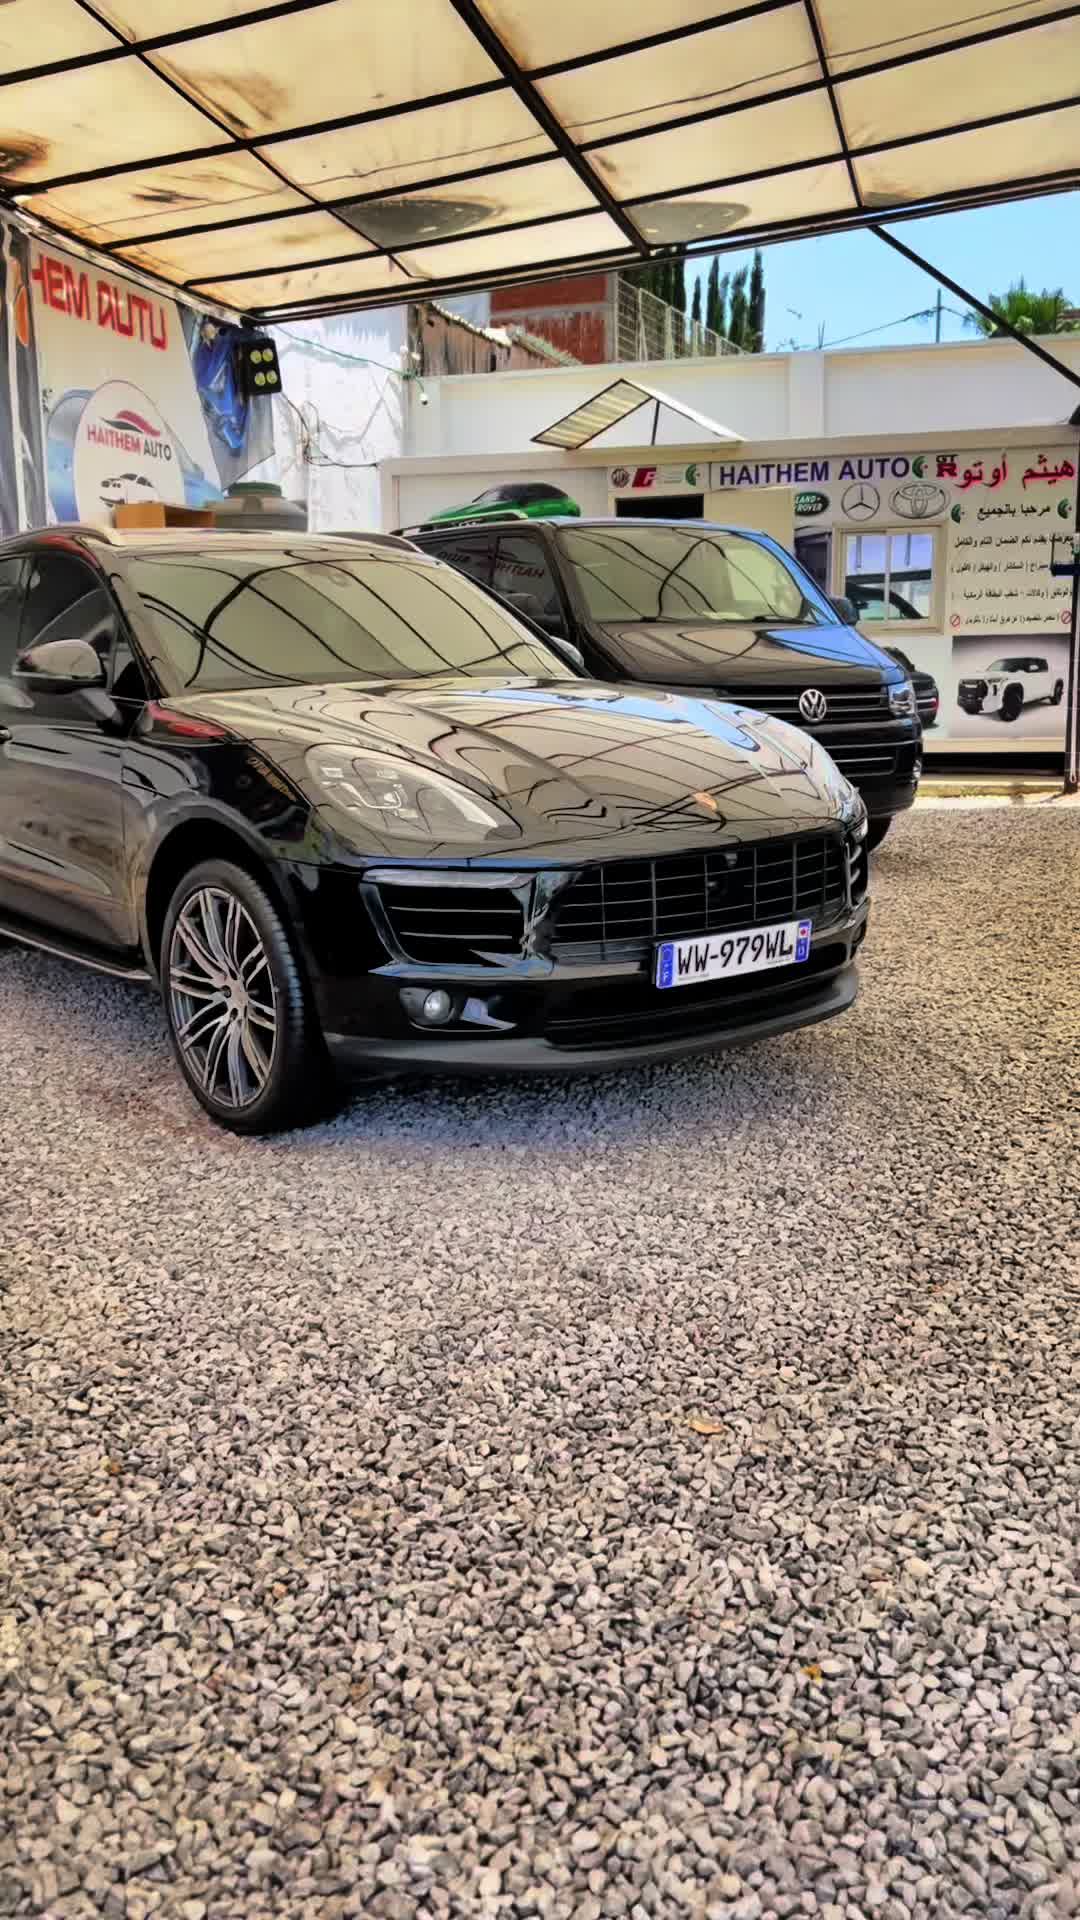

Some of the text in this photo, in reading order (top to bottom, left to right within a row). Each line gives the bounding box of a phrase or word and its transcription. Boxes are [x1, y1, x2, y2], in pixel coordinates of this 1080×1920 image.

[87, 424, 173, 461] HAITHEM AUTO
[719, 457, 910, 486] HAITHEM AUTO
[954, 453, 1075, 489] هيثم أوتو
[795, 495, 817, 504] LAND
[797, 503, 823, 512] ROVER
[1020, 503, 1051, 520] مرحبا
[677, 930, 793, 976] WW-979WL
